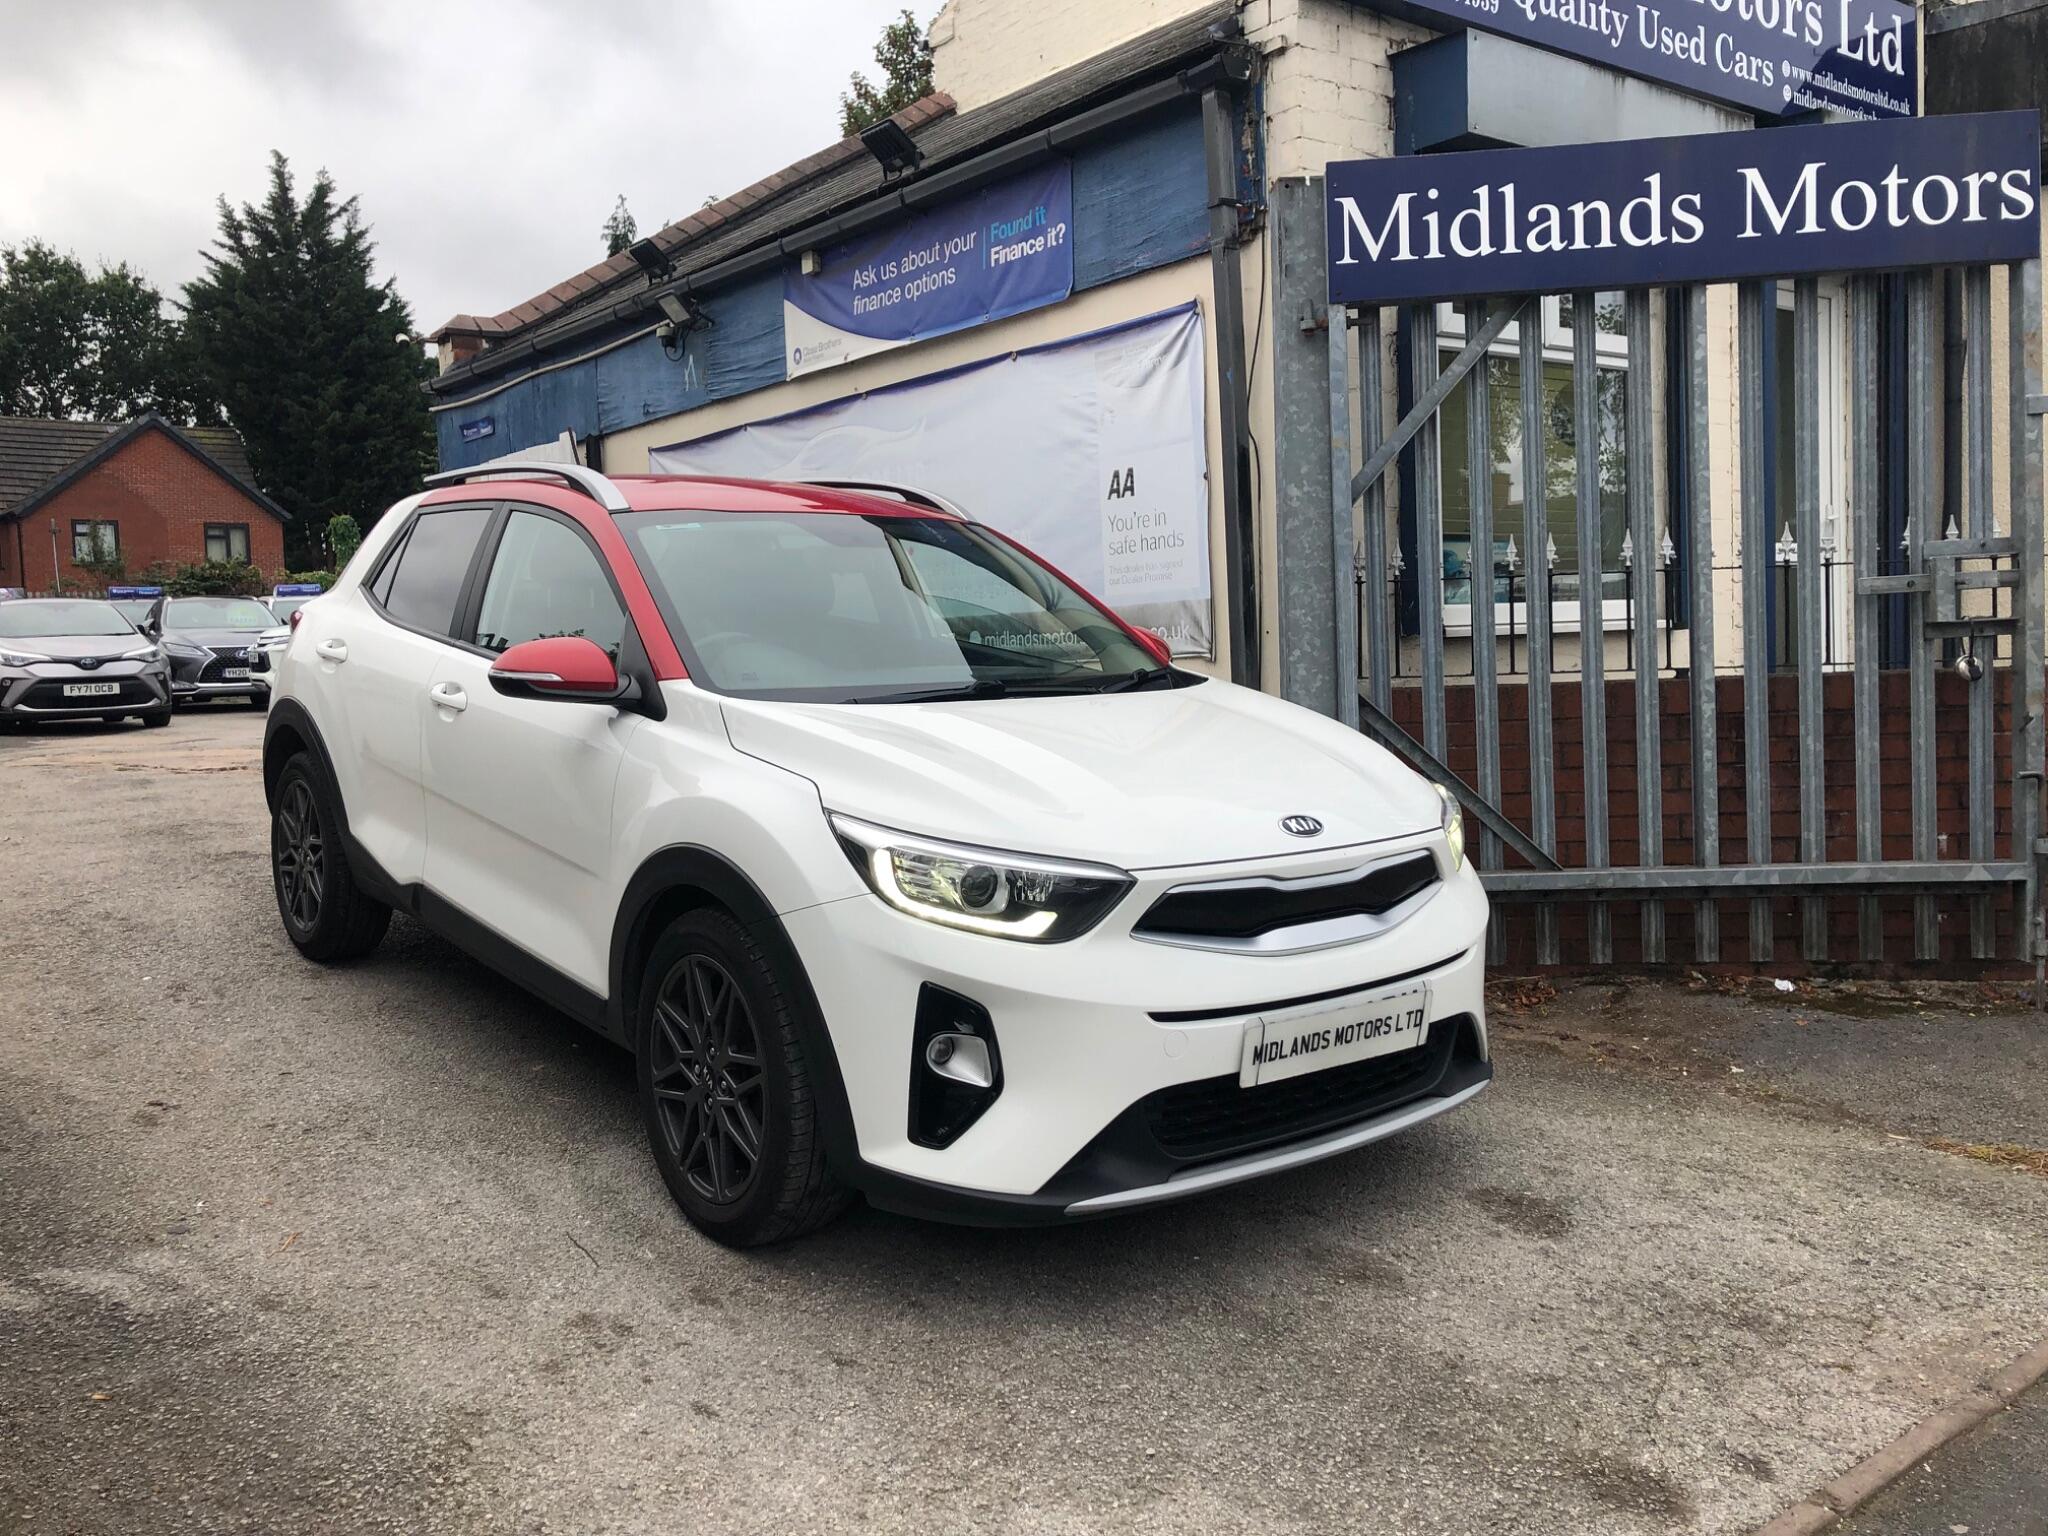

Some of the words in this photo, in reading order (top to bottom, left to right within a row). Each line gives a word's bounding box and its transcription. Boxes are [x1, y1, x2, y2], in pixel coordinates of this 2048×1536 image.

[1636, 5, 1707, 66] Used
[1715, 33, 1774, 87] Cars
[1691, 0, 1824, 46] ors
[1837, 0, 1905, 76] Ltd
[1792, 66, 1910, 116] www.midlandsmotorsltd.co.uk
[991, 211, 1031, 242] Found
[1034, 206, 1047, 226] it
[1335, 172, 1704, 264] Midlands
[1737, 161, 2035, 239] Motors
[853, 268, 878, 291] Ask
[880, 261, 897, 280] us
[901, 243, 940, 274] about
[944, 230, 977, 262] your
[990, 237, 1044, 267] Finance
[1047, 222, 1066, 248] it?
[853, 286, 901, 316] finance
[905, 266, 956, 301] options
[1107, 467, 1135, 500] AA
[1108, 510, 1150, 533] You're
[1154, 507, 1166, 527] in
[1109, 536, 1136, 557] safe
[1140, 530, 1185, 553] hands
[69, 685, 92, 694] FY71
[94, 684, 114, 693] OCB
[226, 668, 247, 676] YH20
[1284, 817, 1321, 832] KIA
[1252, 1030, 1331, 1066] MIDLANDS
[1334, 1016, 1393, 1047] MOTORS
[1395, 1009, 1424, 1033] LTD
